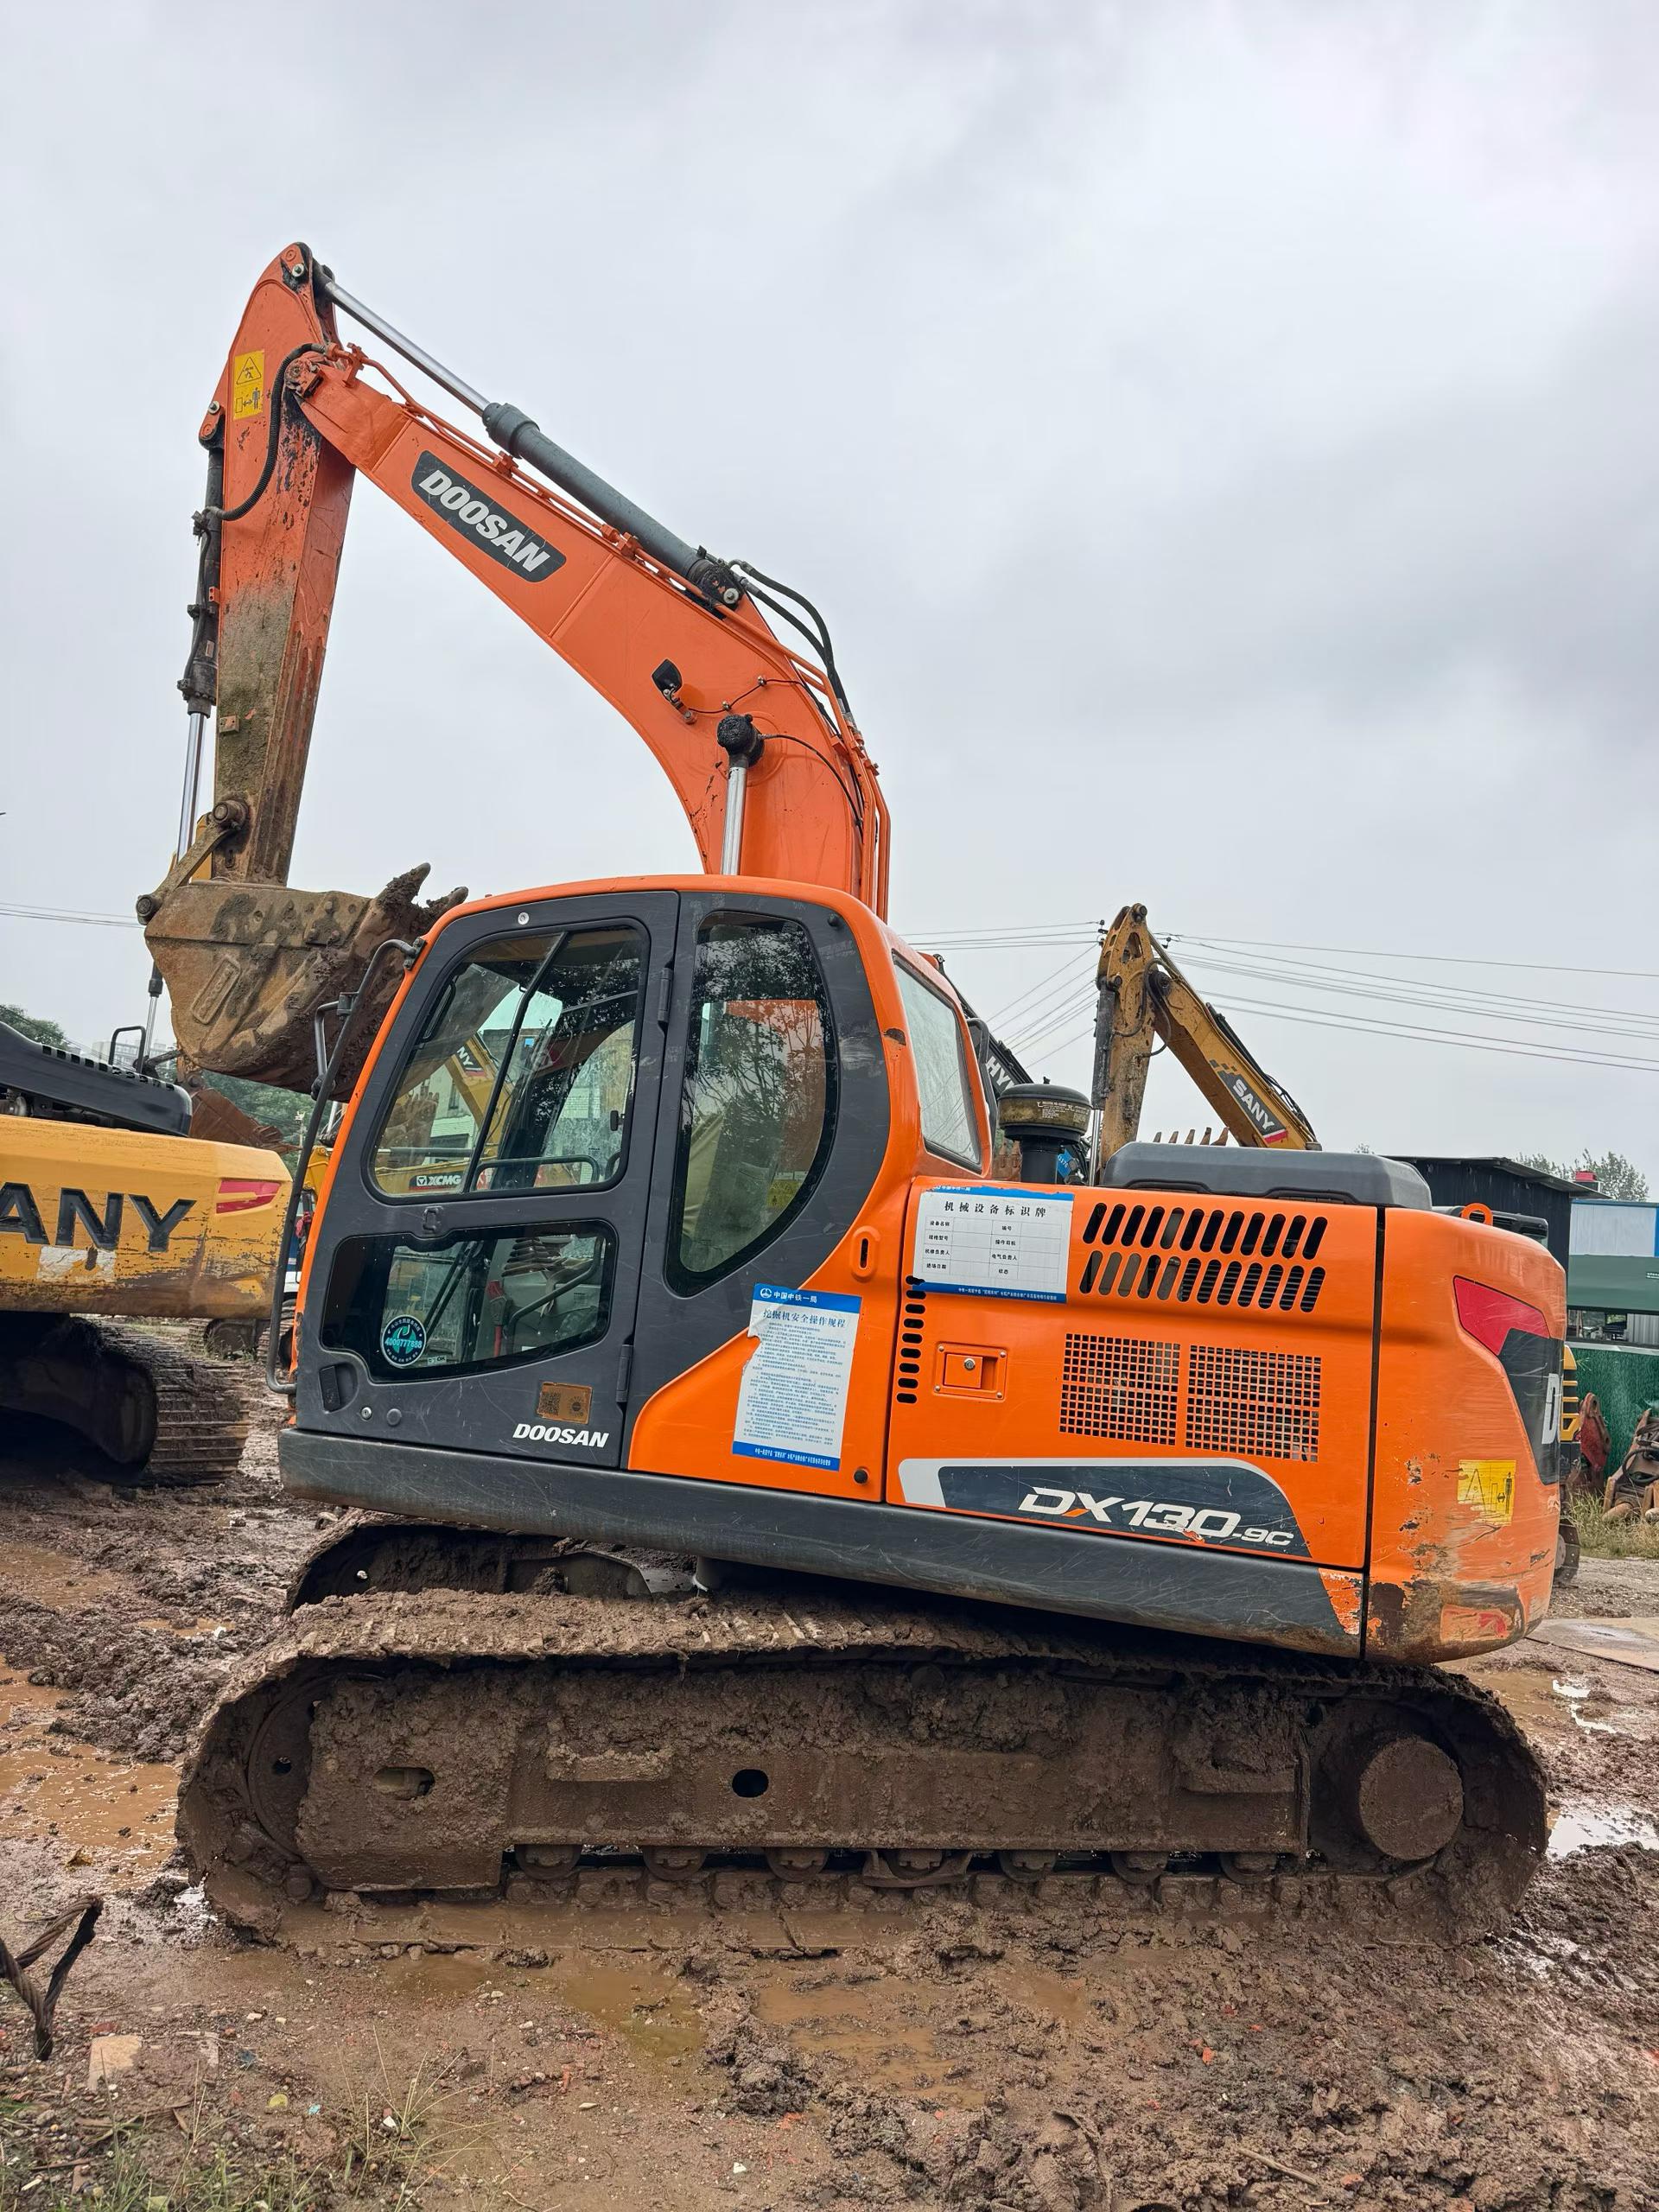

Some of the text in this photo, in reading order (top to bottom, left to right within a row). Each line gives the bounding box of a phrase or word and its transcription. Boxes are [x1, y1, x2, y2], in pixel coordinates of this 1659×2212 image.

[418, 469, 550, 572] DOOSAN
[1232, 1078, 1275, 1129] SANY
[428, 1174, 461, 1185] XCMG
[0, 1181, 196, 1252] ANY
[944, 1200, 1046, 1217] 机械设备标识牌
[773, 1291, 817, 1304] 中国中铁一局
[763, 1308, 846, 1328] 挖掘机安全操作规程
[512, 1423, 609, 1448] DOOSAN
